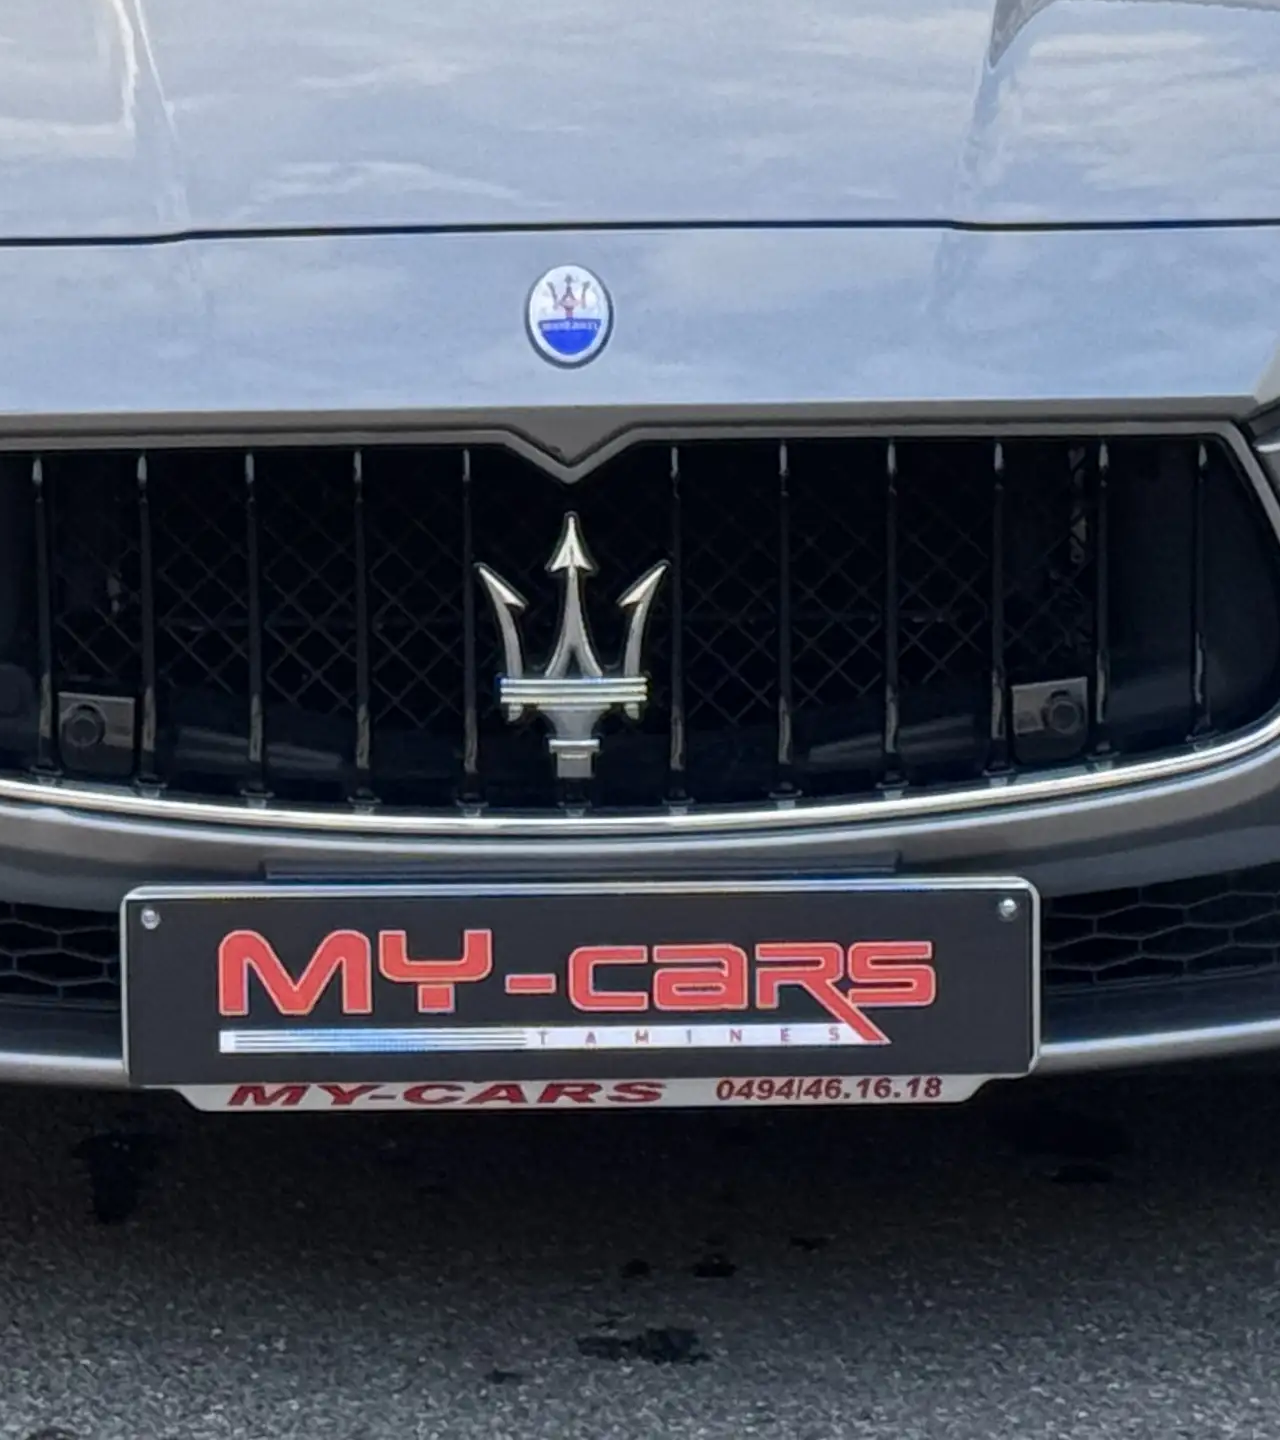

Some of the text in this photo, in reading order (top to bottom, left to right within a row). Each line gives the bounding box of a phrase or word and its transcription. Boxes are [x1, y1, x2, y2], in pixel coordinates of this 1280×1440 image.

[536, 1027, 841, 1046] TAMINES
[226, 1076, 943, 1107] MY-CARS 0494/46.16.18
